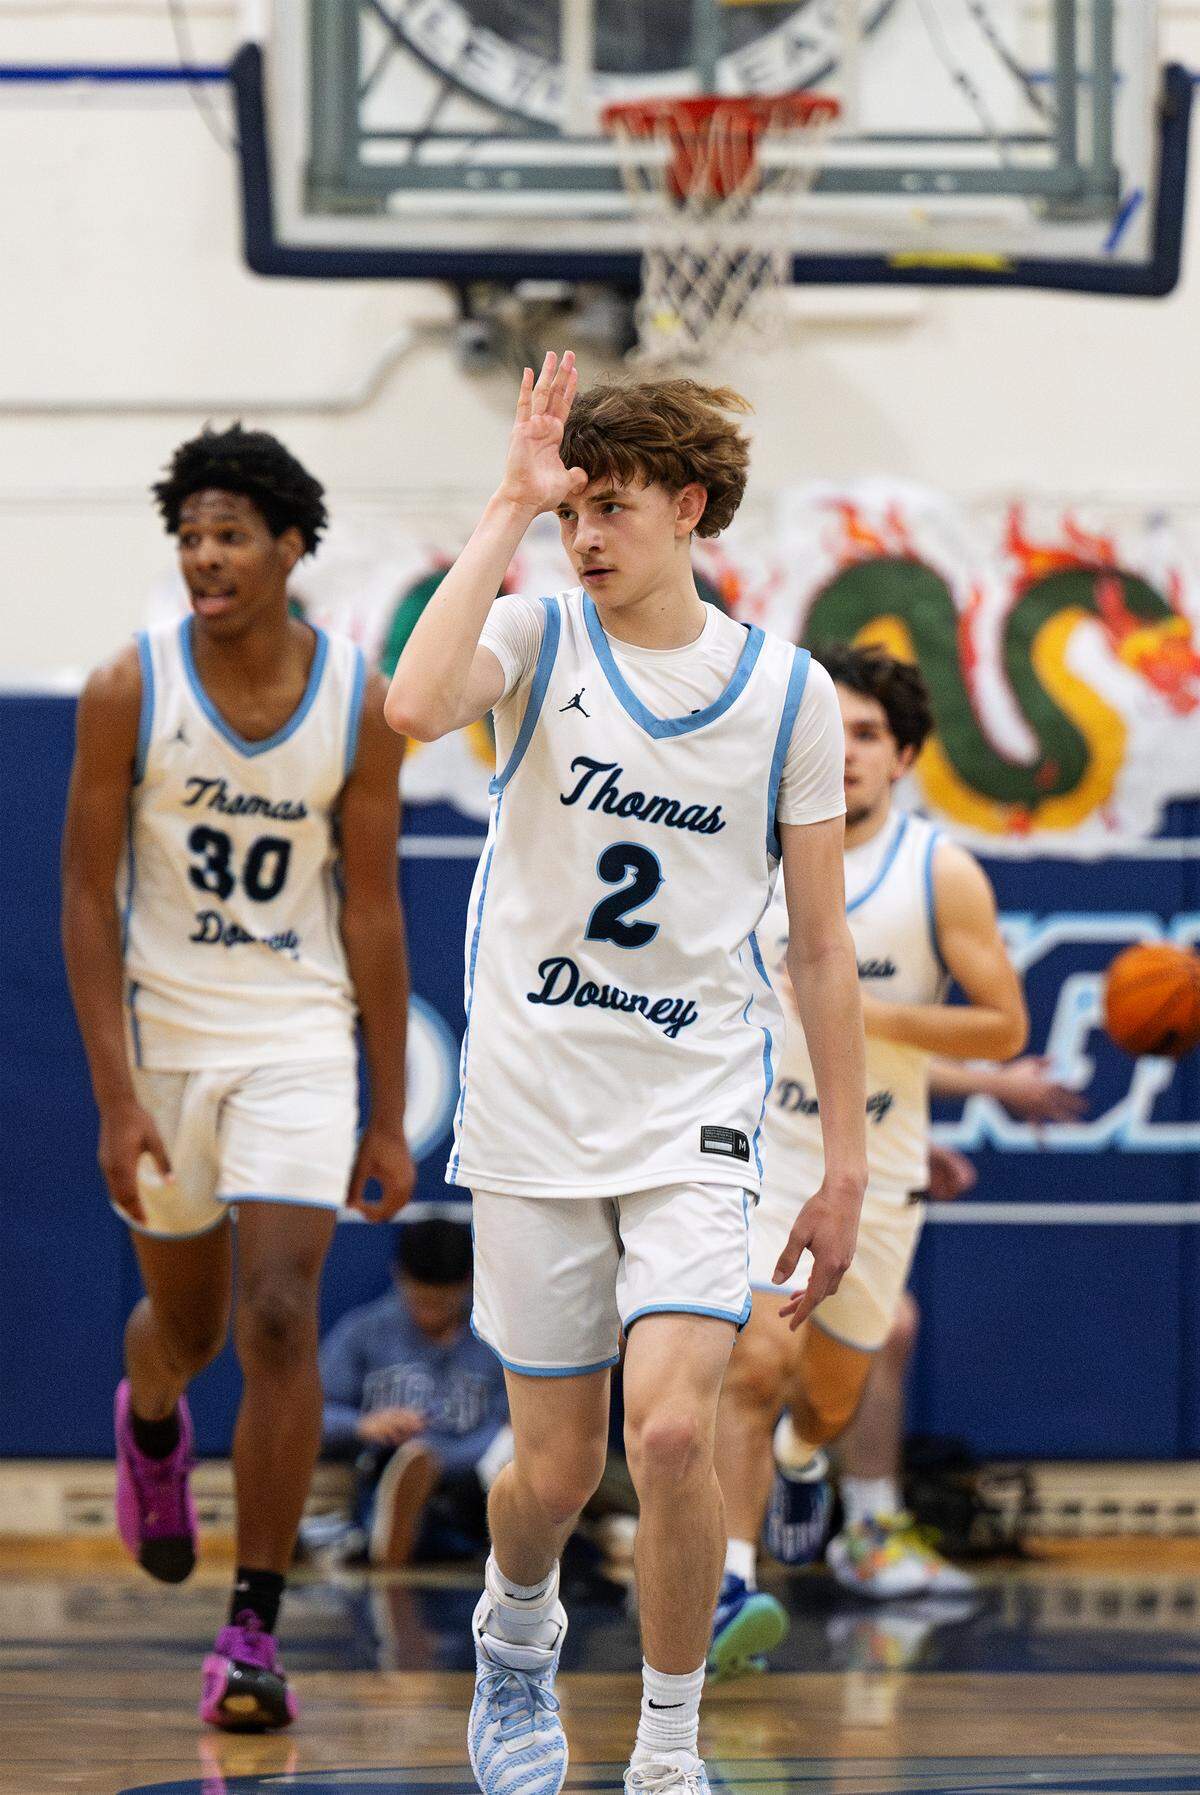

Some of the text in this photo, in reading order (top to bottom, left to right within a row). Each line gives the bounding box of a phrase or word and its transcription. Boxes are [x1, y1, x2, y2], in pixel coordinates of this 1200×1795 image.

[184, 776, 308, 821] Thomas
[559, 755, 727, 835] Thomas
[188, 824, 293, 902] 30
[584, 841, 666, 950] 2
[190, 909, 300, 960] Doey
[526, 956, 699, 1039] Downey
[738, 1138, 747, 1152] M
